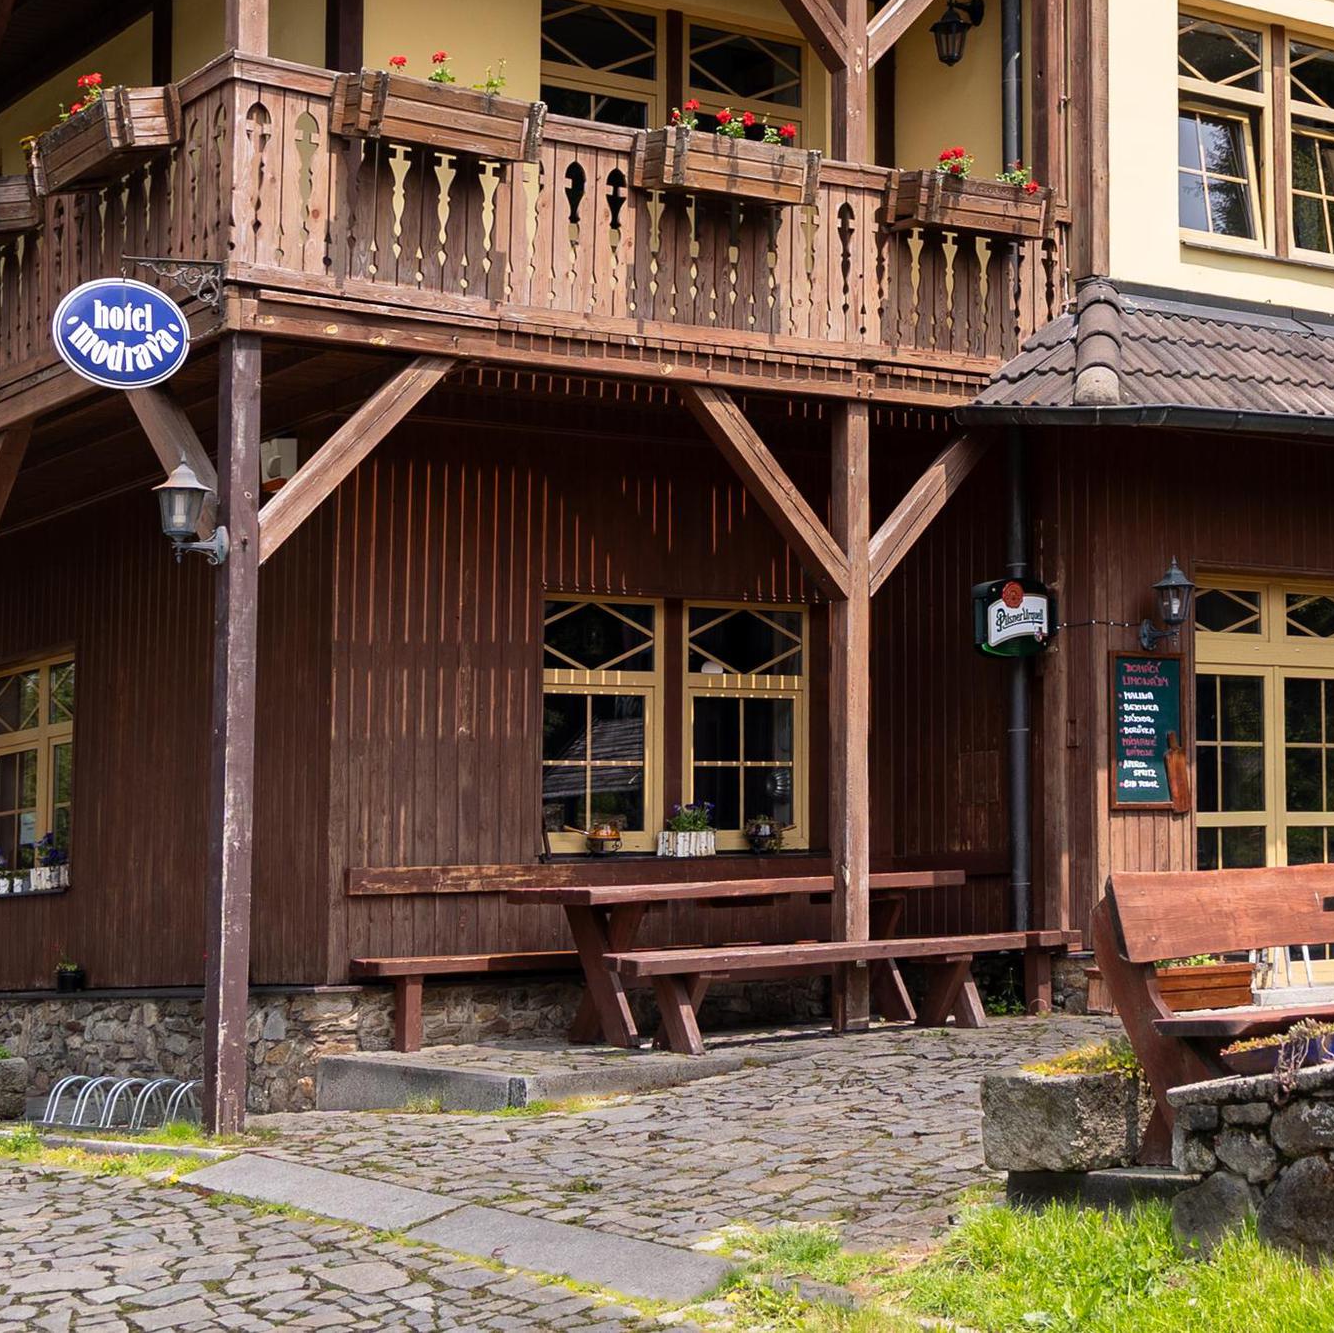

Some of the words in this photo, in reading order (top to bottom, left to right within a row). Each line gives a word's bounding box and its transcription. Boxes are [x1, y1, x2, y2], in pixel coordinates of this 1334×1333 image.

[93, 299, 153, 332] hotel
[68, 321, 179, 372] modrava
[996, 608, 1022, 632] Pilsner
[1022, 607, 1044, 626] Urquell
